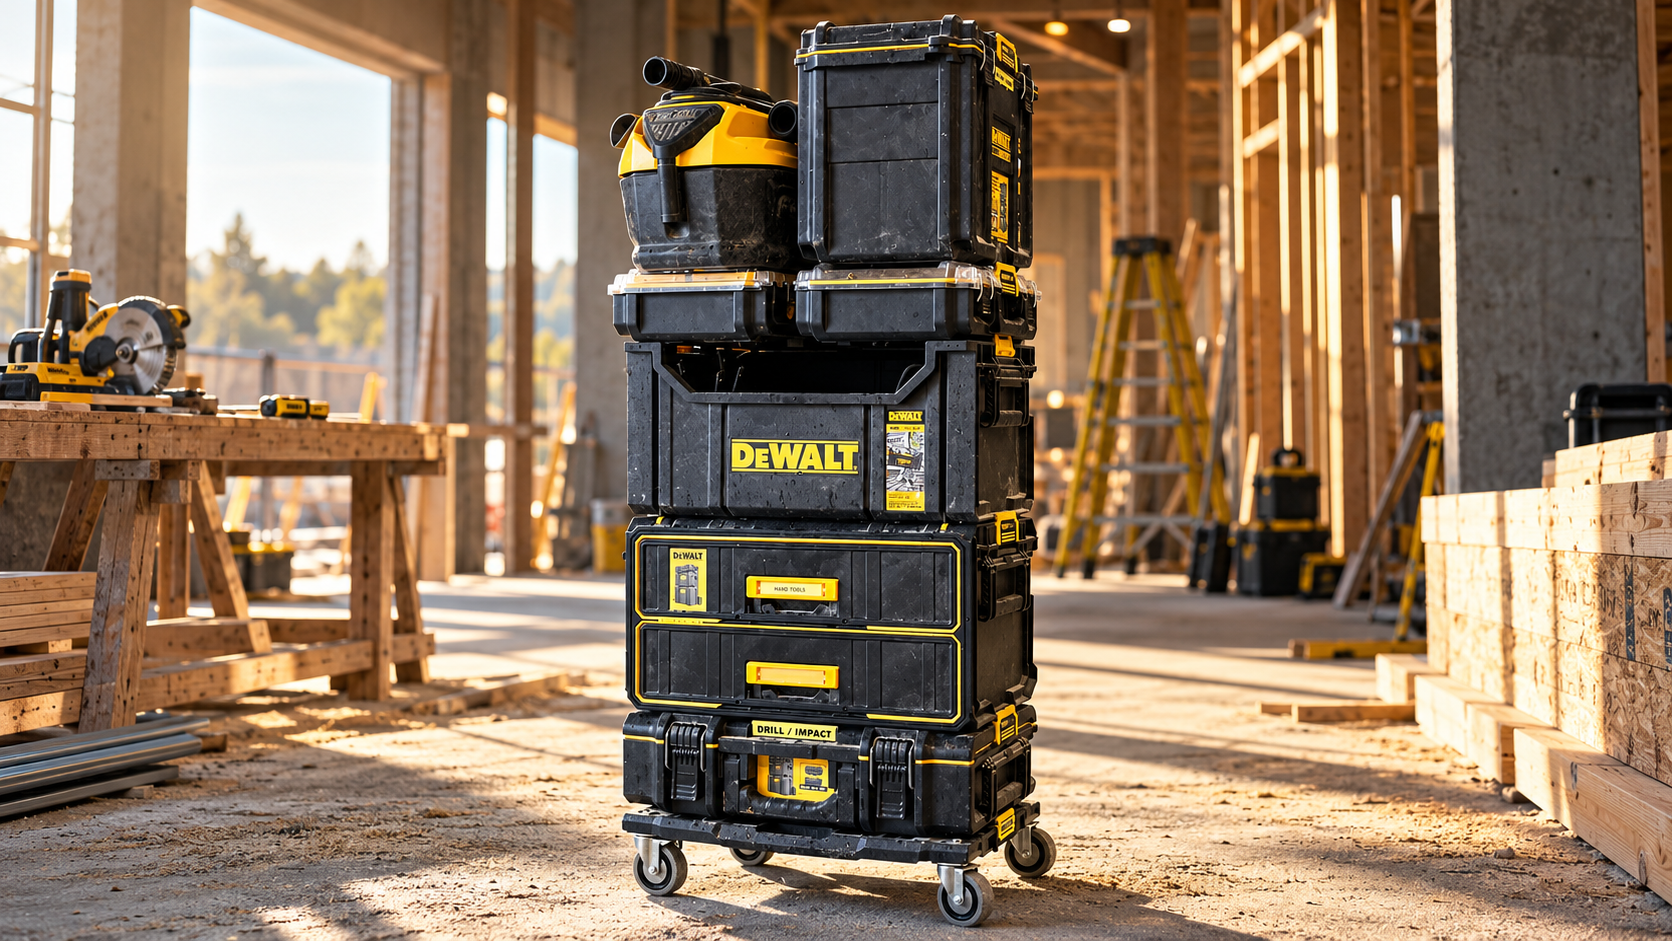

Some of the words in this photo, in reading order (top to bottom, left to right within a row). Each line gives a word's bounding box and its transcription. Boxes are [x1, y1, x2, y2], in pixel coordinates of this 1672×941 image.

[757, 725, 784, 735] DRILL
[787, 727, 792, 736] /
[795, 728, 832, 738] IMPACT
